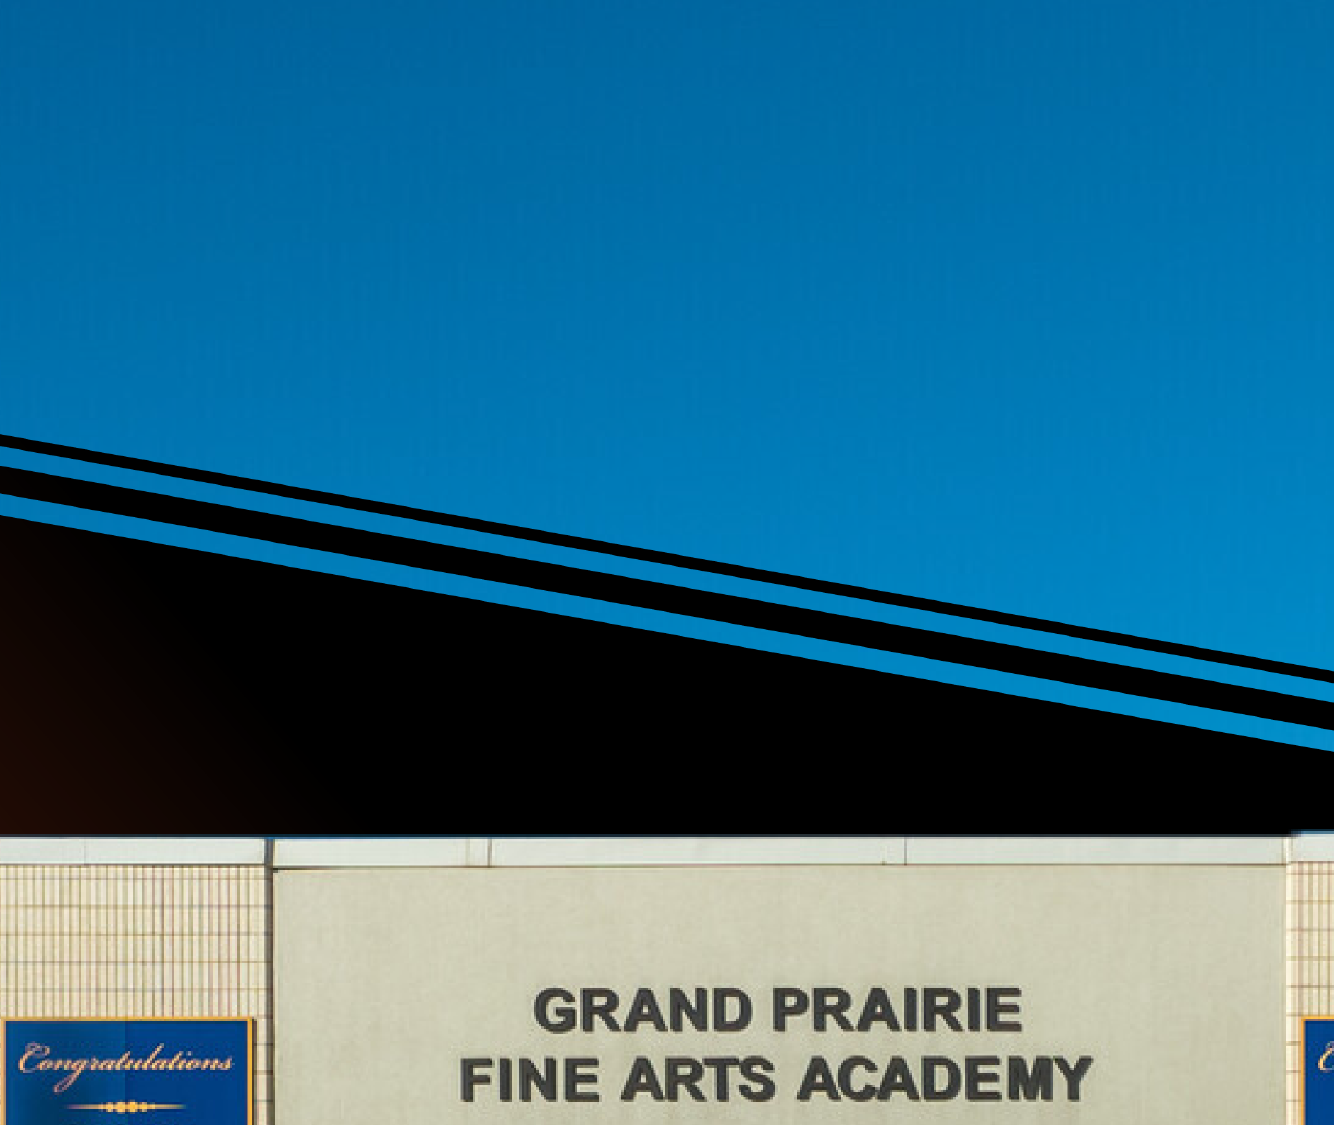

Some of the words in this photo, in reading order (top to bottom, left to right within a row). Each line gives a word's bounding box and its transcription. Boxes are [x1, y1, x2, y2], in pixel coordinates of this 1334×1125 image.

[533, 987, 752, 1034] GRAND
[772, 987, 1022, 1032] PRAIRIE
[18, 1042, 233, 1093] Congratulations
[459, 1057, 600, 1102] FINE
[620, 1056, 776, 1103] ARTS
[796, 1056, 1094, 1103] ACADEMY
